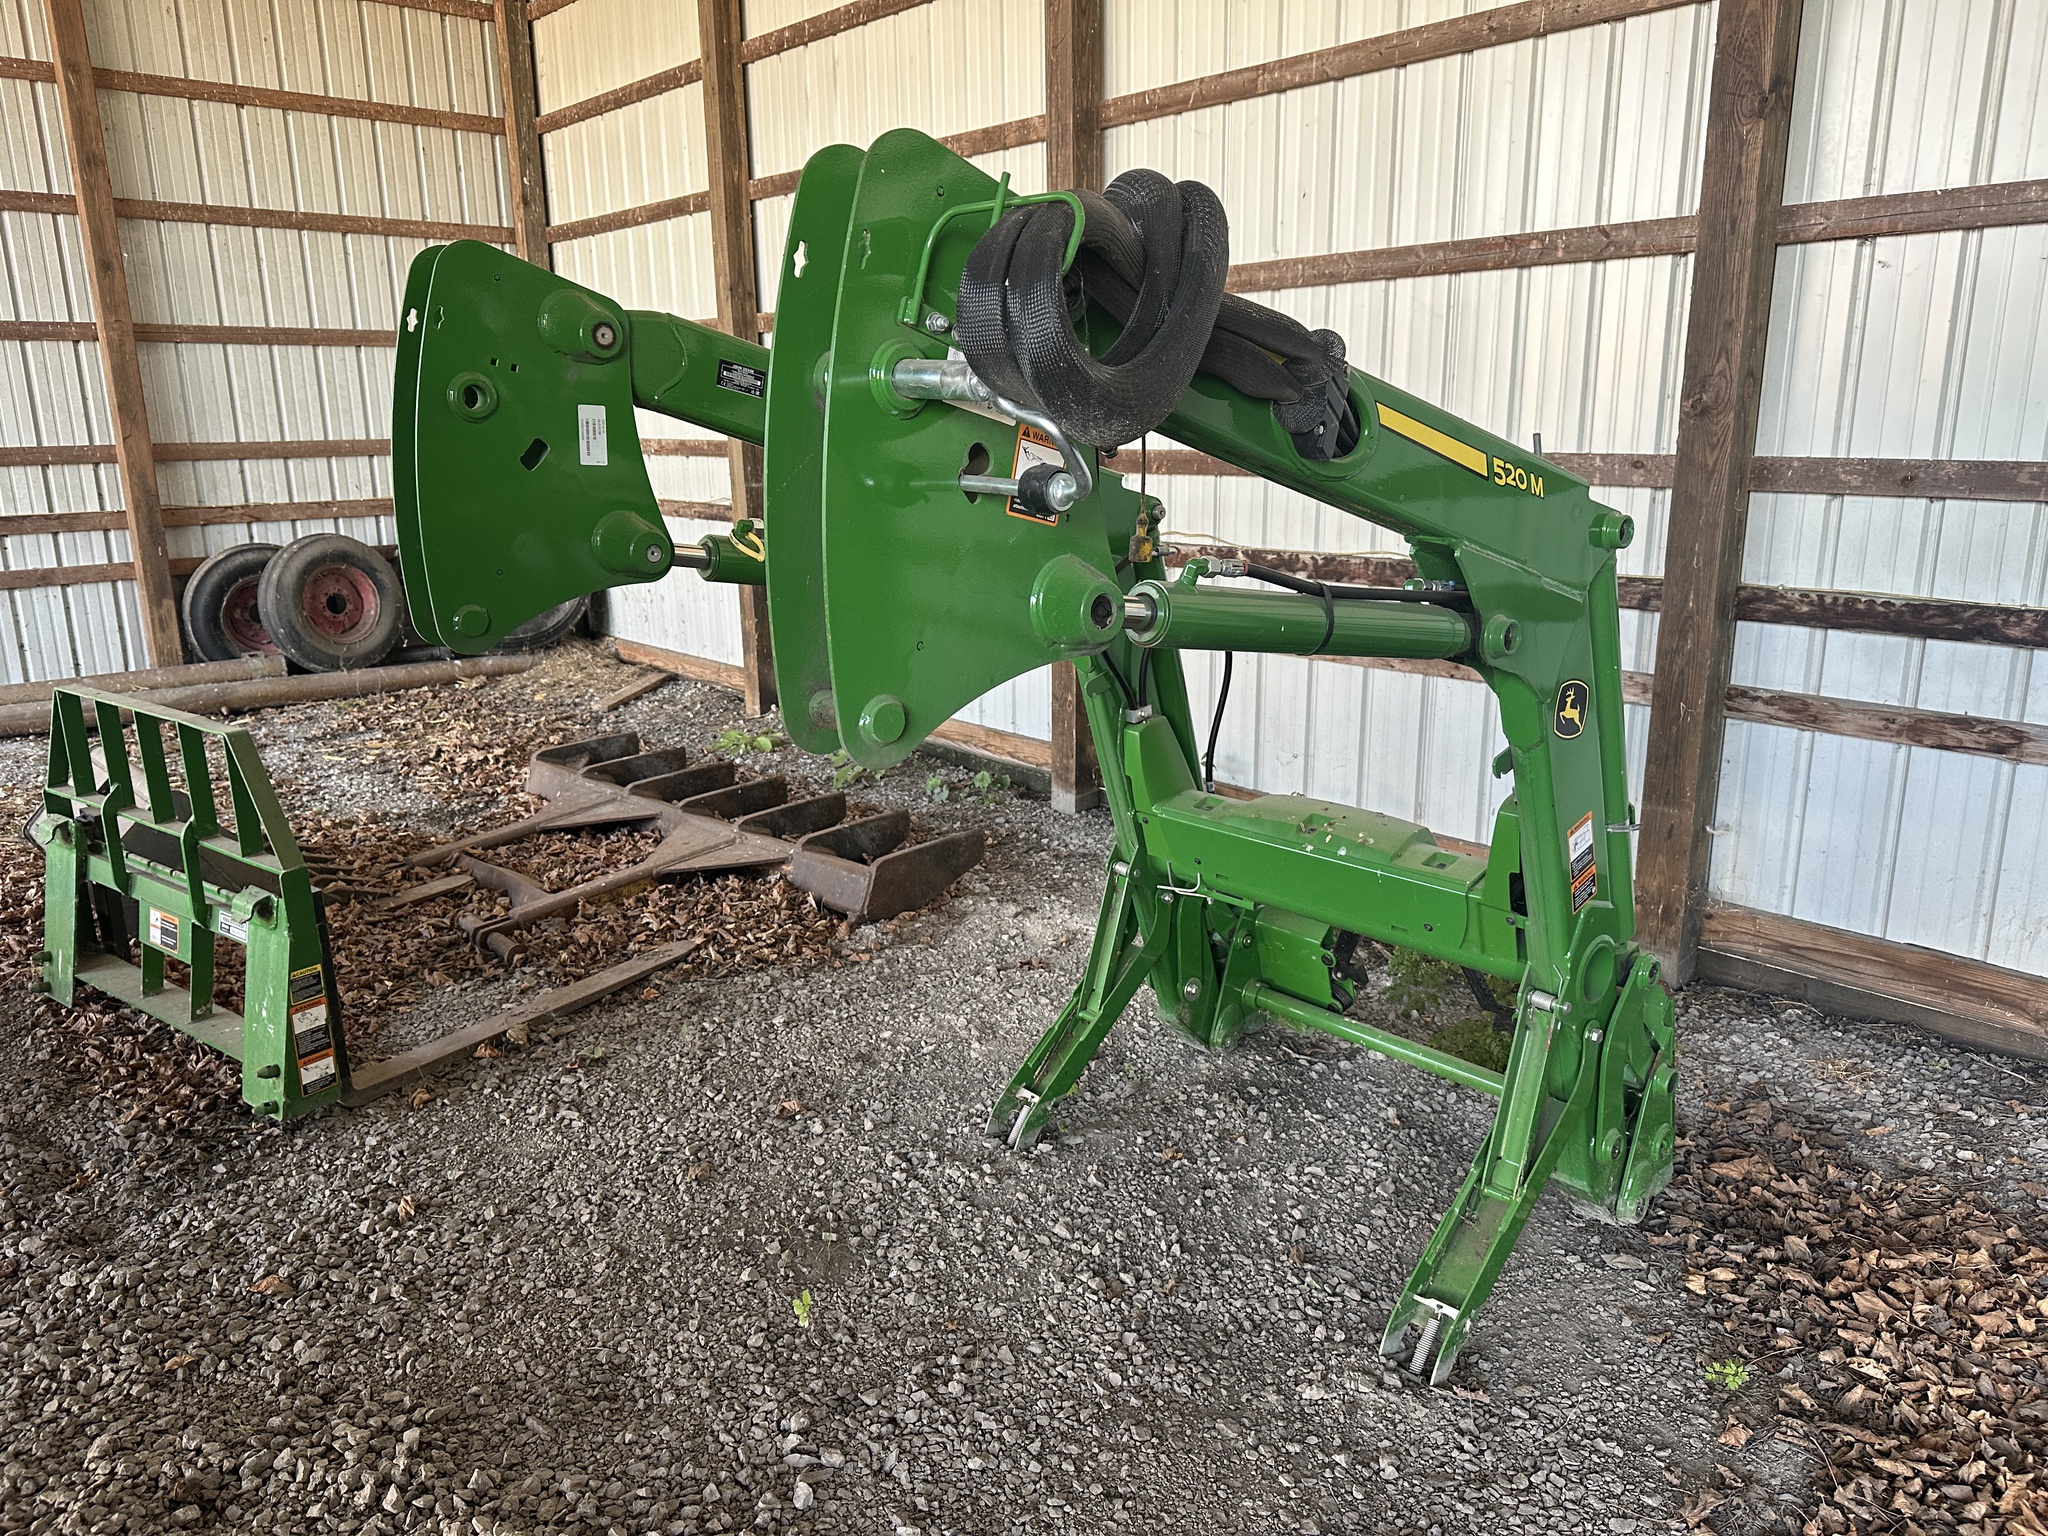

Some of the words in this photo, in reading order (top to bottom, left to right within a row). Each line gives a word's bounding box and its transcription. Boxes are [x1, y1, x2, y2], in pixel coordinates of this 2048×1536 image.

[1032, 431, 1055, 446] WARN
[1493, 455, 1528, 491] 520
[1530, 472, 1544, 499] M
[296, 966, 318, 976] CAUTION
